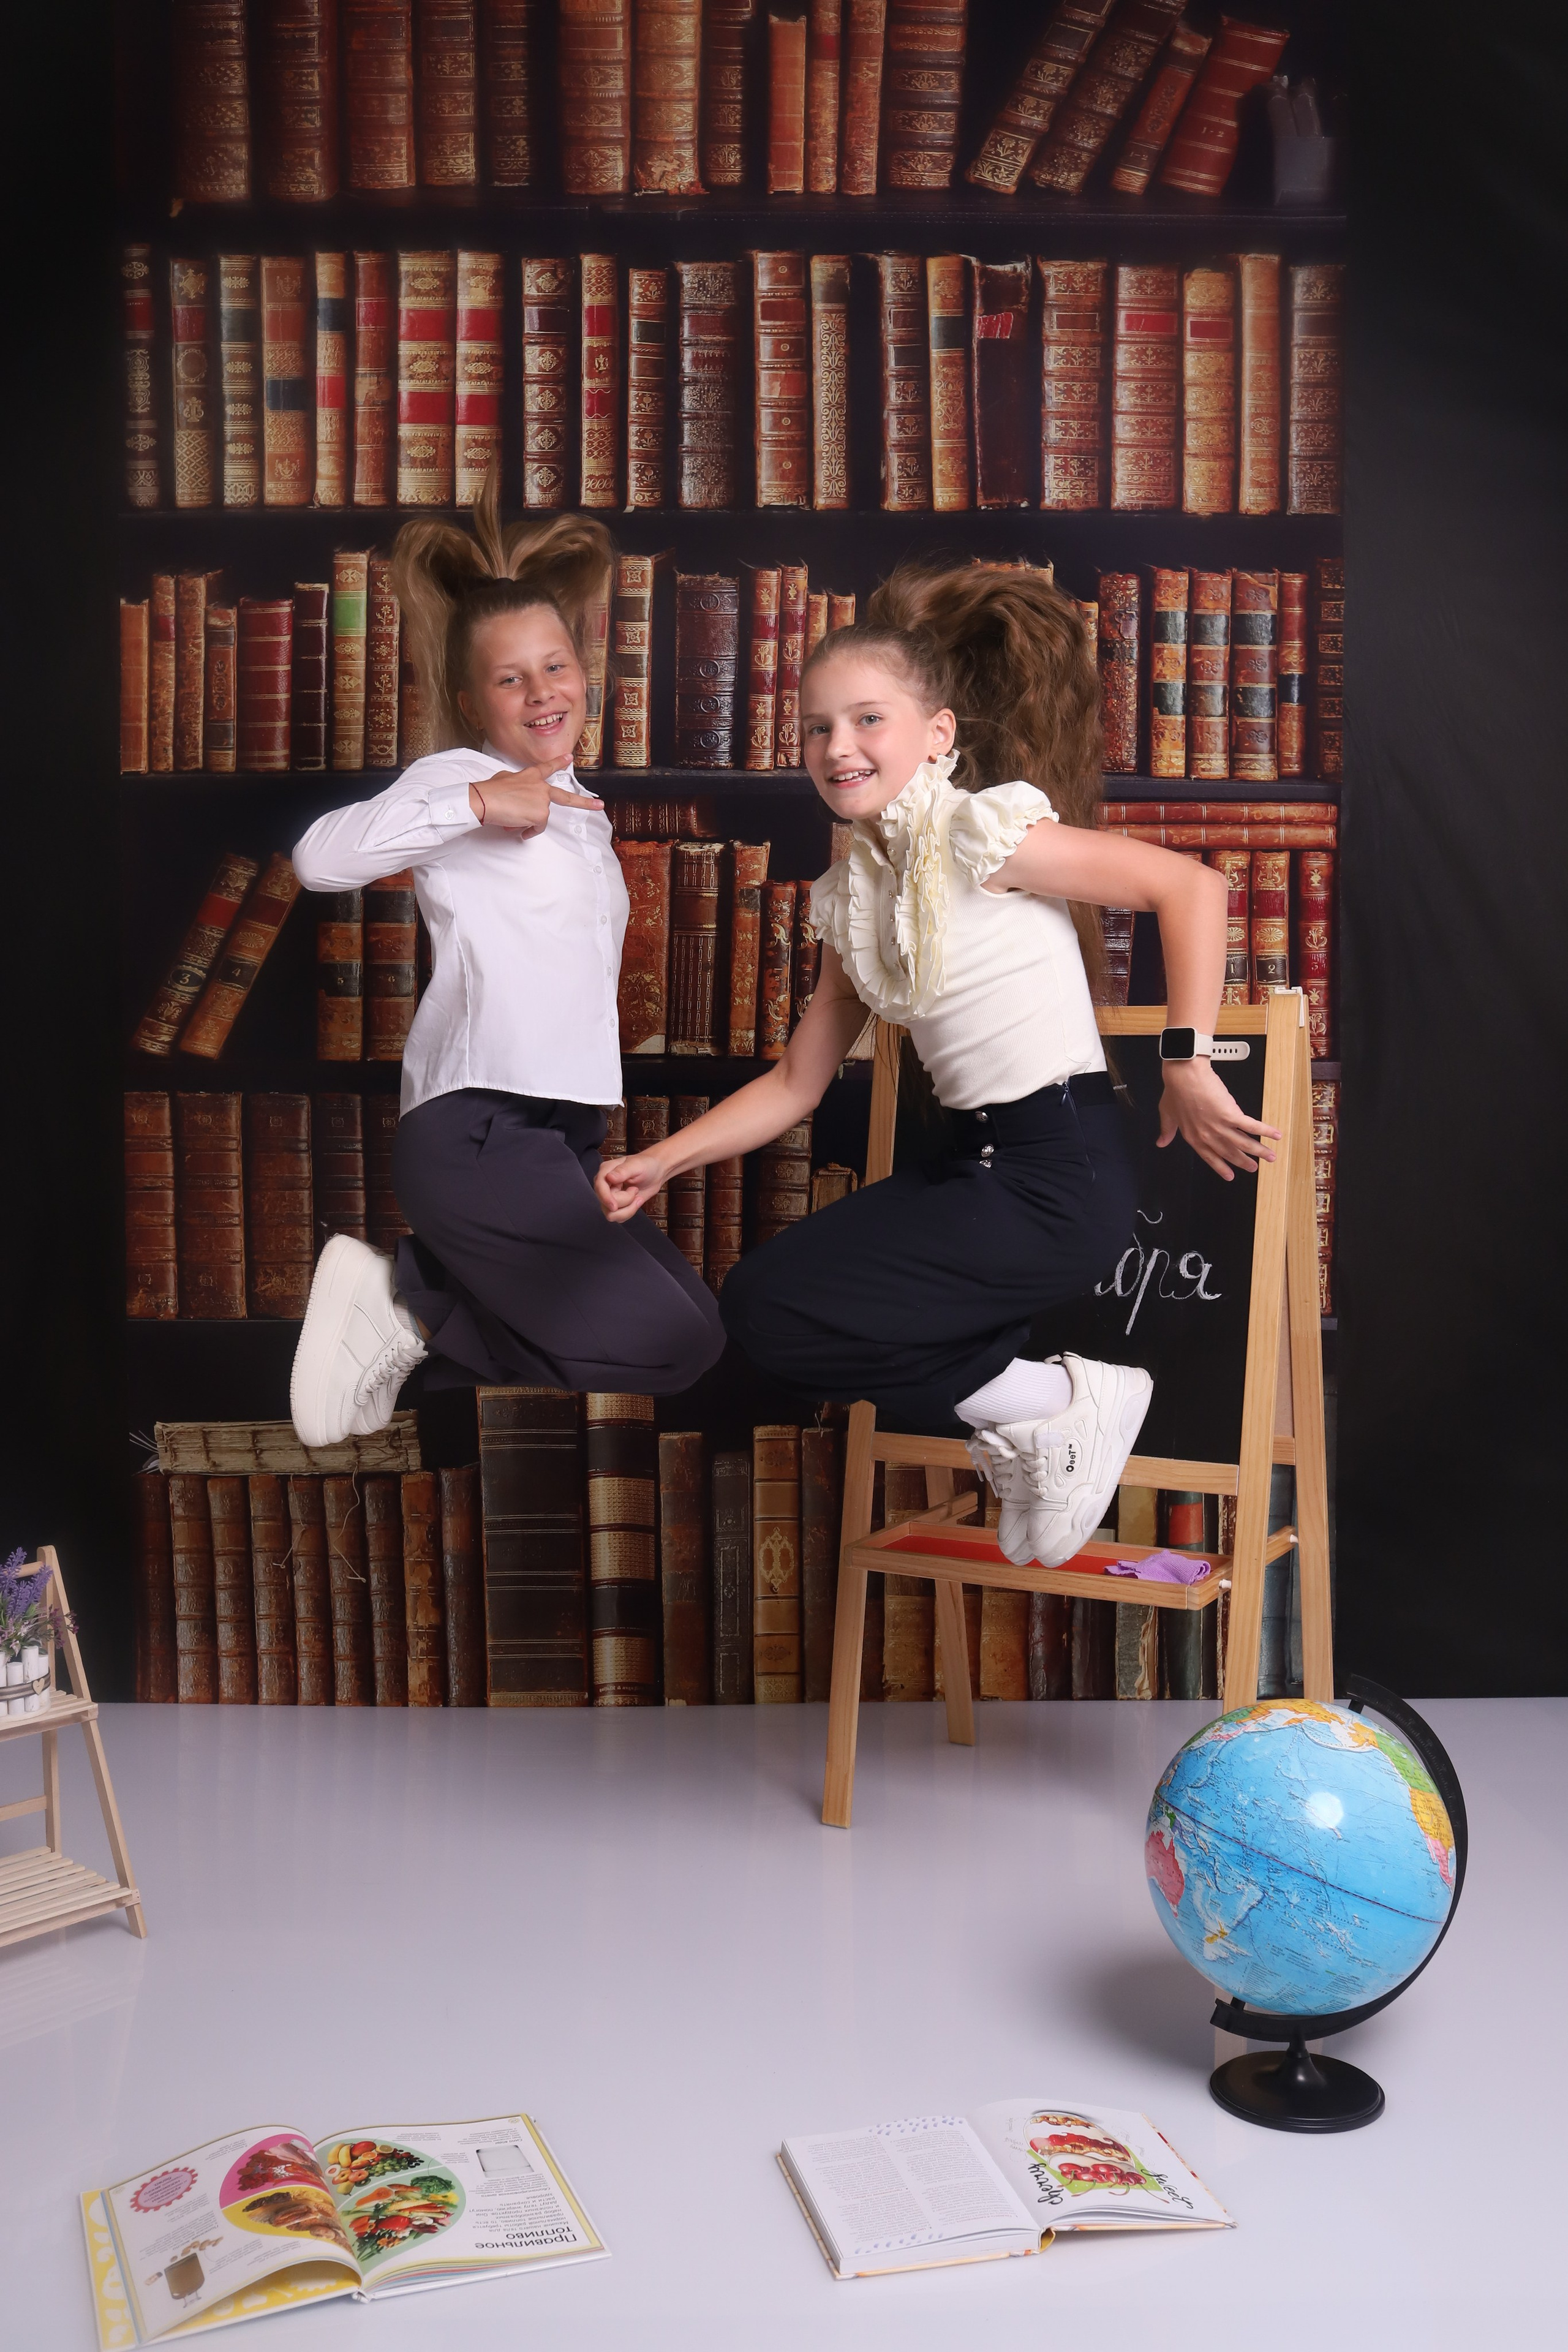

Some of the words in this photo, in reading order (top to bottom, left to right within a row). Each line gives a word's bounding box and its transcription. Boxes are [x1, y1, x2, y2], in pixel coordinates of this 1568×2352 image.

[232, 968, 241, 978] 4
[1267, 963, 1276, 974] 2
[179, 973, 190, 984] 3
[506, 2226, 573, 2239] топливо
[475, 2234, 578, 2249] Правильное
